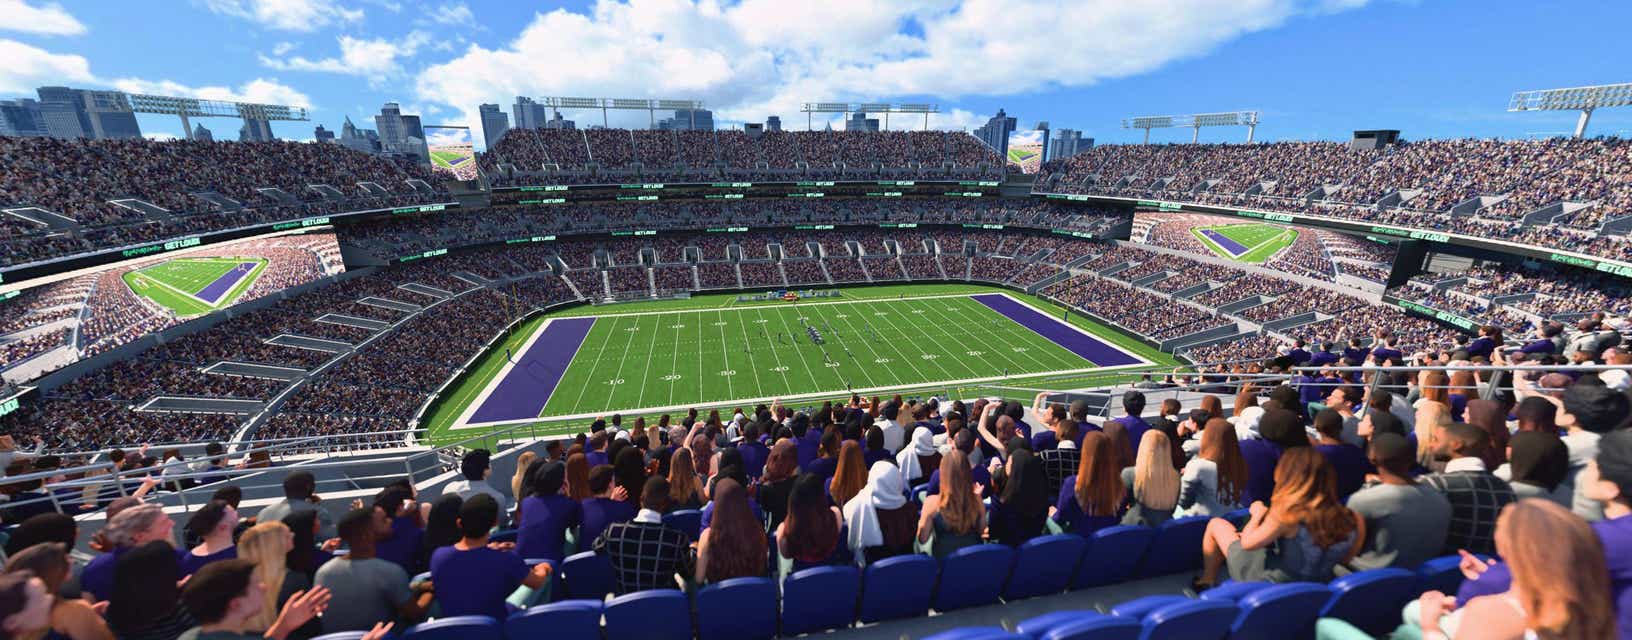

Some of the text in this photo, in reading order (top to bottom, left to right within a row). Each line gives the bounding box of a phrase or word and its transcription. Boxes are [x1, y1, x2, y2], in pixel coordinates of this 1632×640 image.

[302, 218, 314, 226] GET
[164, 241, 179, 250] GET
[1596, 262, 1632, 278] GET LO
[1436, 311, 1452, 323] GET
